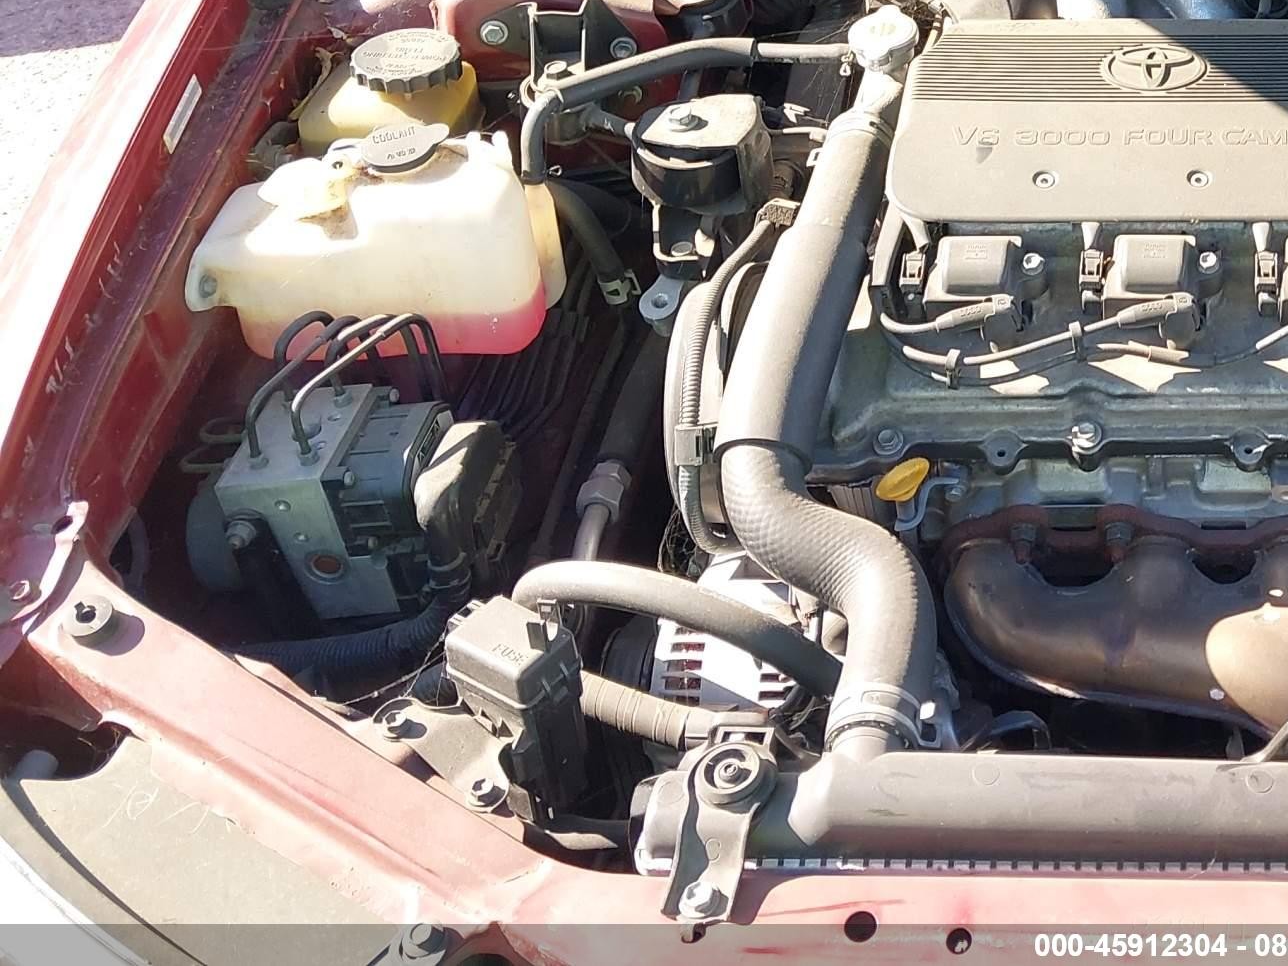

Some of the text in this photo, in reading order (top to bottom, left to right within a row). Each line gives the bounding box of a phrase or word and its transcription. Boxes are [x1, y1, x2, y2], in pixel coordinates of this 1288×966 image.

[371, 125, 417, 144] COOLANT
[953, 125, 1000, 146] V6
[1014, 128, 1111, 147] 3000
[1123, 128, 1214, 147] FOUR
[1221, 127, 1288, 147] CAM
[491, 644, 524, 665] FUSE
